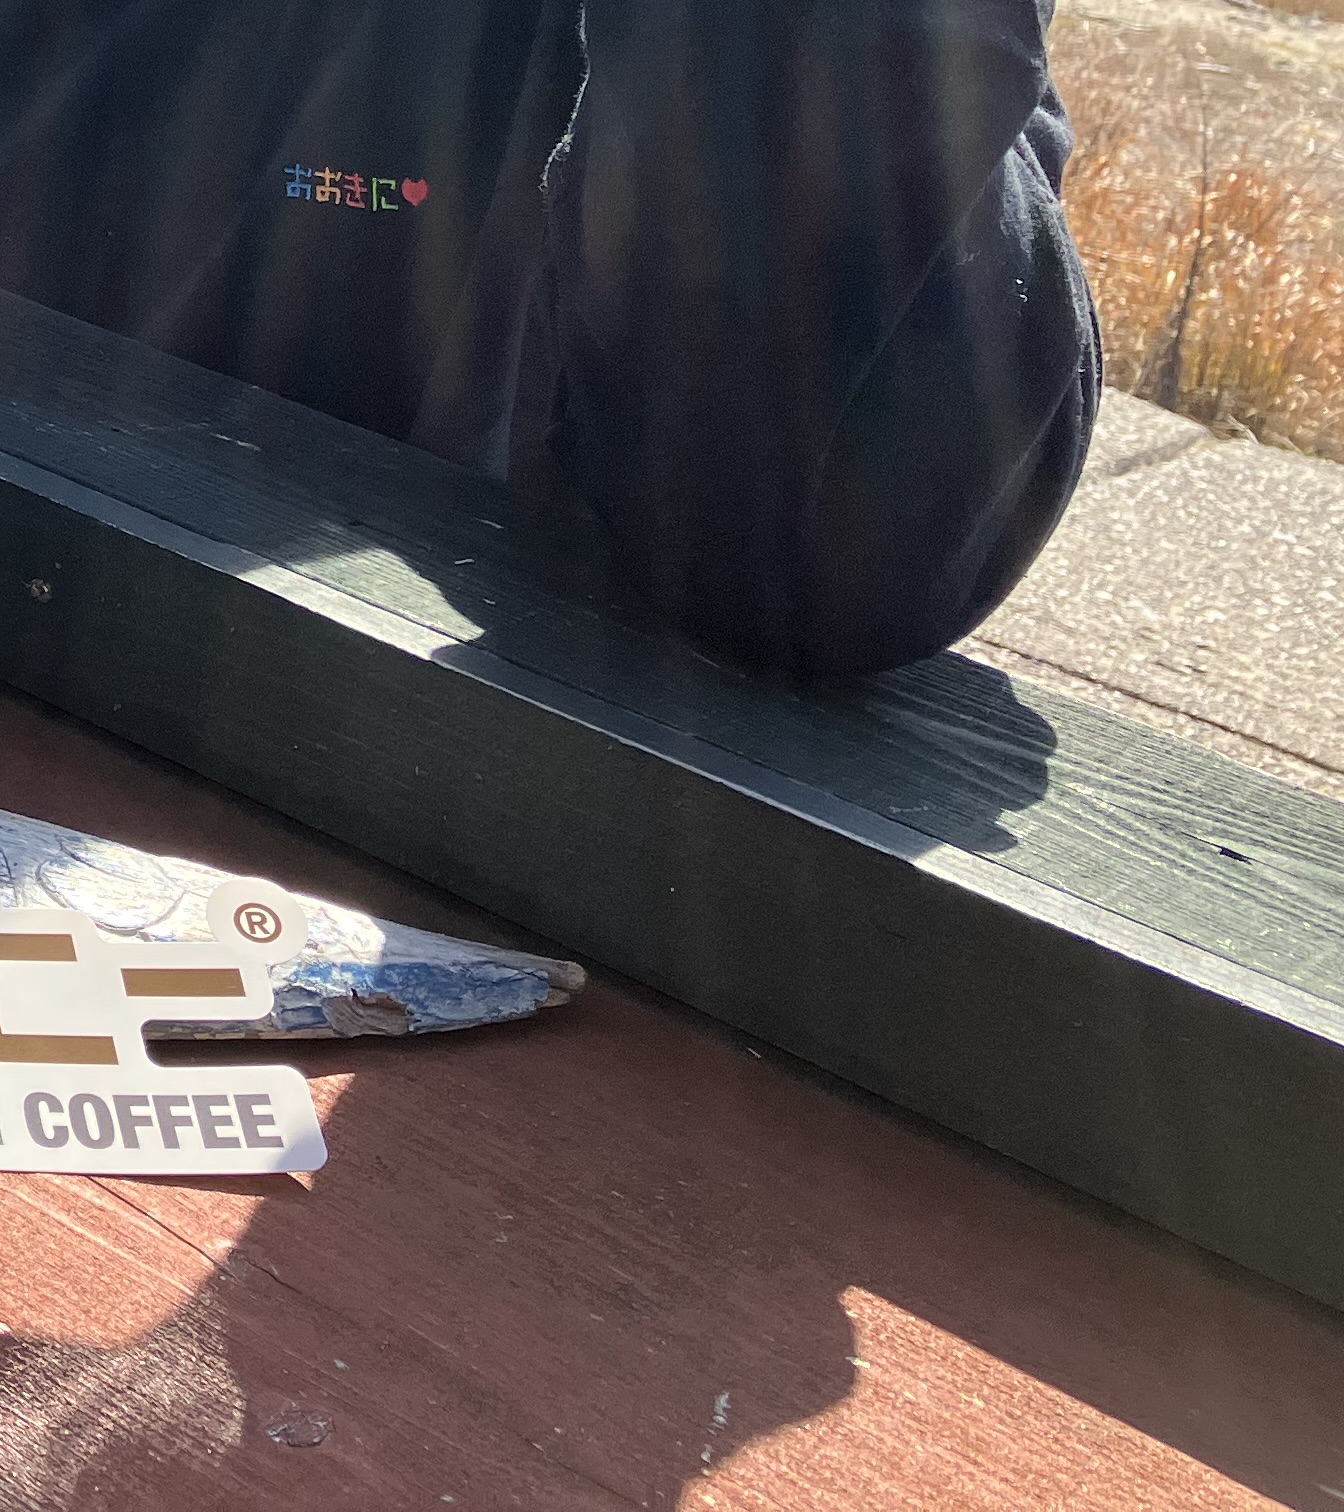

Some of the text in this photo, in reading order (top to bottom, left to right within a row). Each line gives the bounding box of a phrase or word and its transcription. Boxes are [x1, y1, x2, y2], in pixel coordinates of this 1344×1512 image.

[283, 163, 399, 212] おおきに
[24, 1093, 284, 1151] COFFEE
